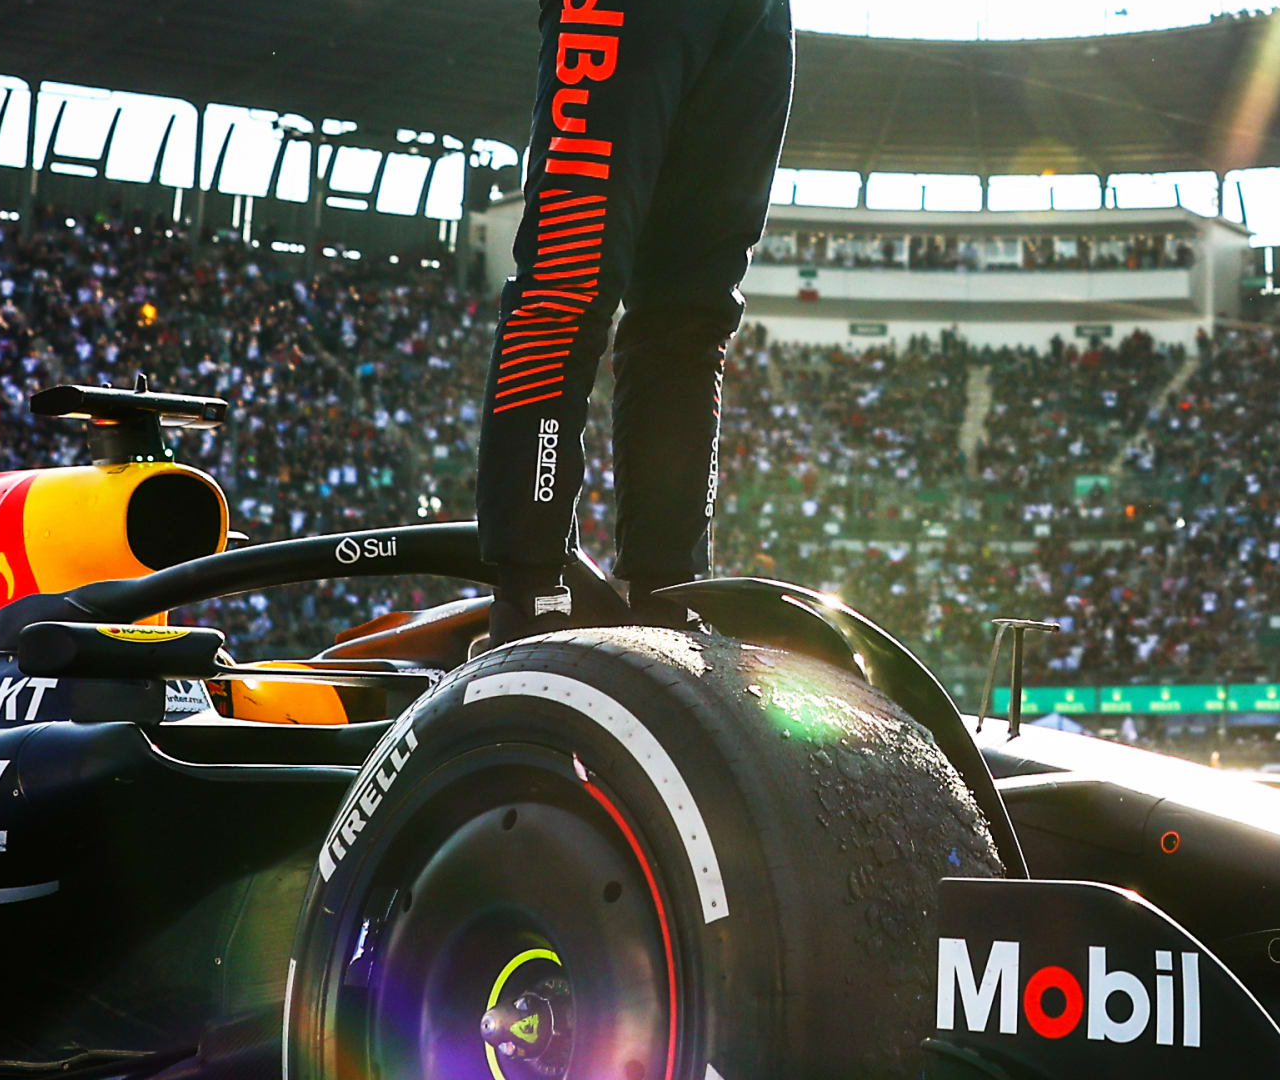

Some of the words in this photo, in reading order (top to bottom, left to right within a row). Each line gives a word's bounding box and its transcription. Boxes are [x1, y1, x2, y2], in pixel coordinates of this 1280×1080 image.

[545, 31, 620, 180] Bull
[534, 418, 560, 503] sparco
[363, 537, 397, 559] Sui
[319, 712, 419, 883] PIRELLI
[935, 937, 1201, 1048] Mobil
